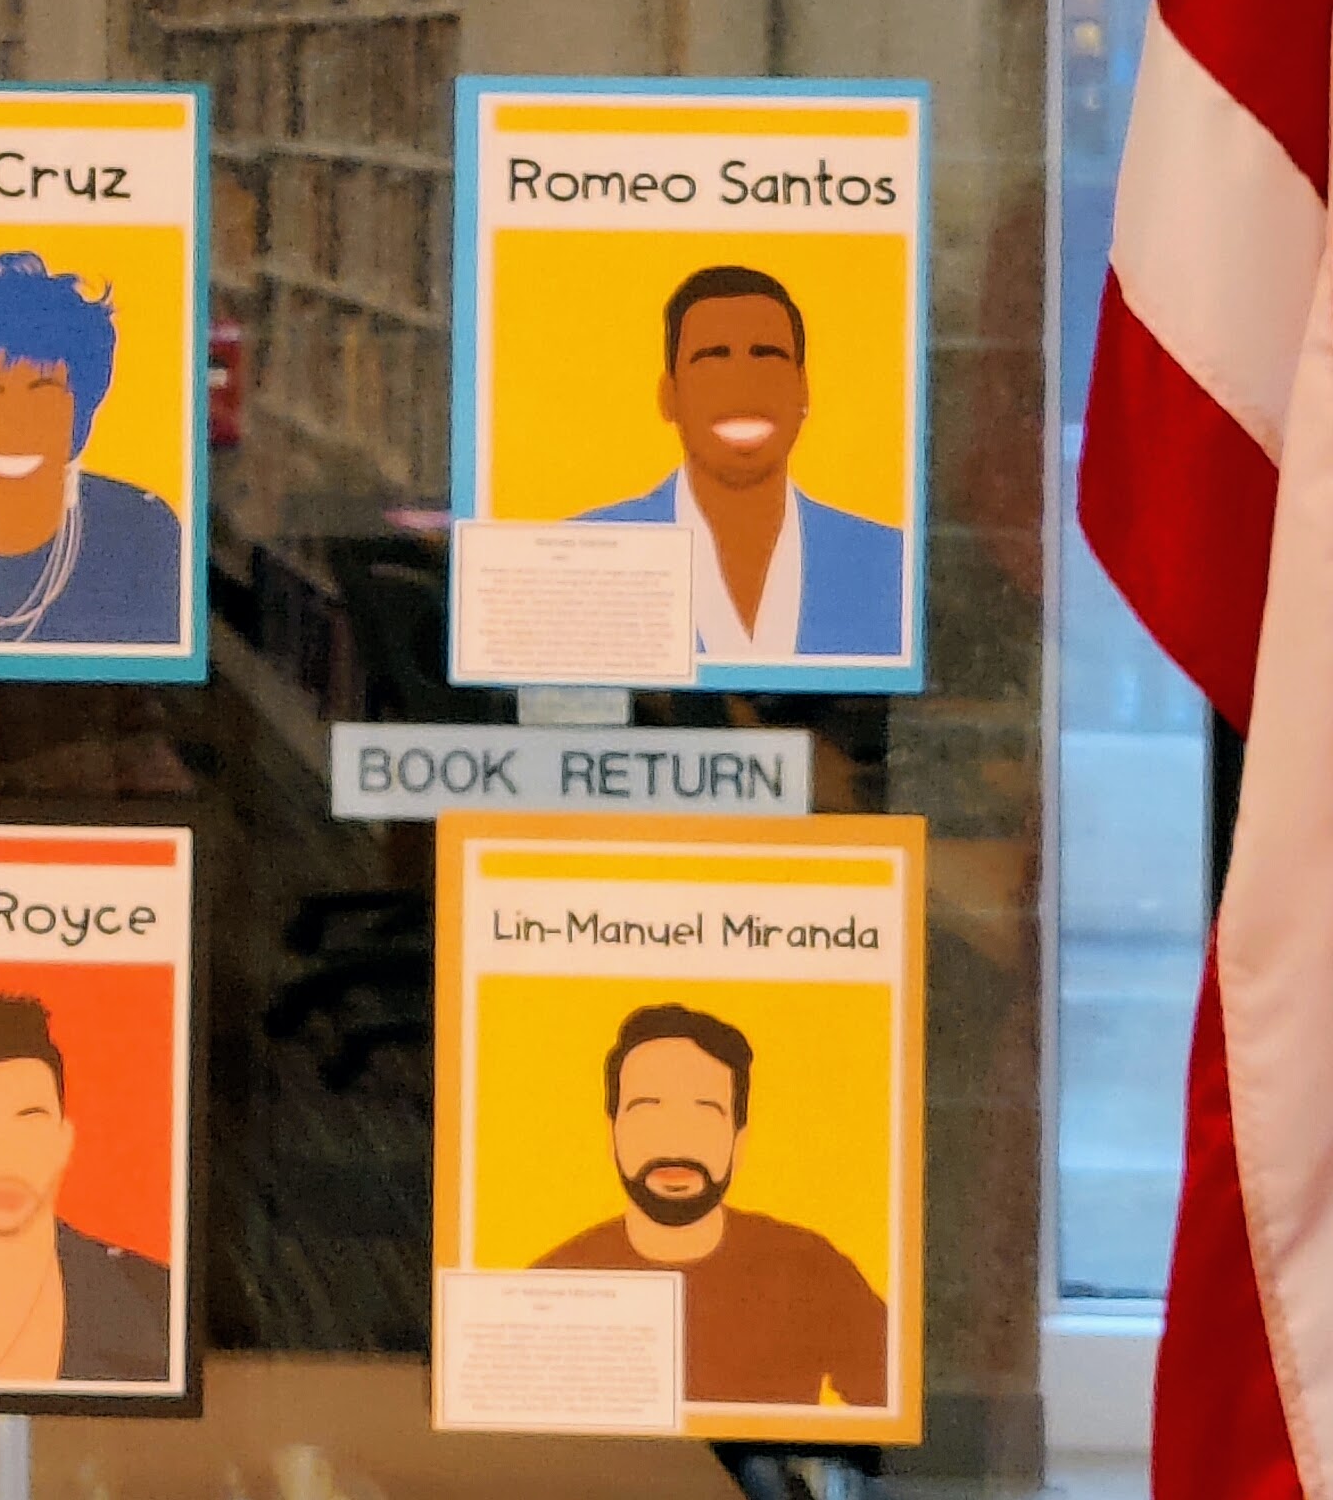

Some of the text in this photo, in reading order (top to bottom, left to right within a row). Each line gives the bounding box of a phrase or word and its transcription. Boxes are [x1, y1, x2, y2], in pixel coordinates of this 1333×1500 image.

[509, 157, 897, 206] Romeo Santos
[359, 748, 785, 799] BOOK RETURN
[493, 910, 879, 950] Lin-Manuel Miranda
